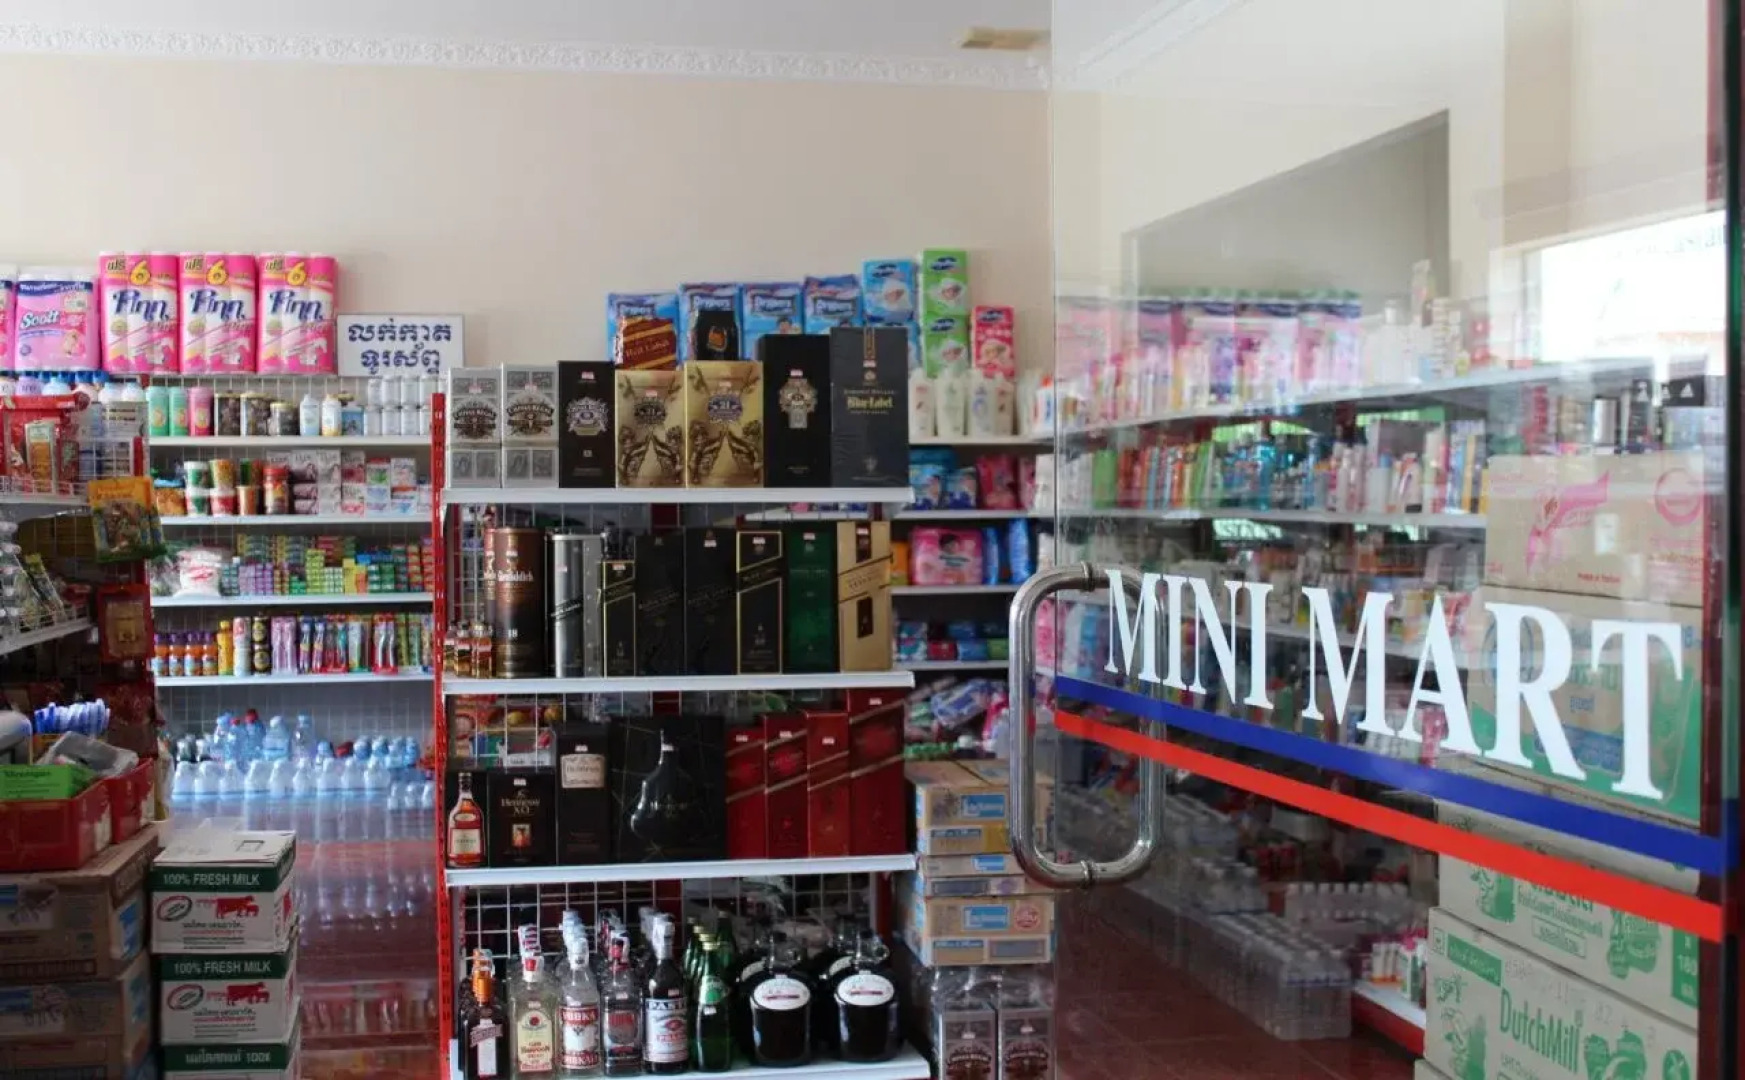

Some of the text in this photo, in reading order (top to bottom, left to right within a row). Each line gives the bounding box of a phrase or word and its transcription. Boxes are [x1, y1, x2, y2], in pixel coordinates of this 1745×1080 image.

[129, 260, 151, 286] 6
[207, 260, 229, 286] 6
[287, 261, 309, 287] 6
[112, 289, 169, 322] Finn
[190, 289, 246, 322] Finn
[268, 289, 324, 322] Finn
[21, 310, 60, 329] Scott
[1104, 569, 1684, 800] MINI MART
[163, 873, 261, 885] 100% FRESH MILK
[174, 959, 271, 975] 100% FRESH MILK
[1500, 988, 1580, 1075] DutchMill
